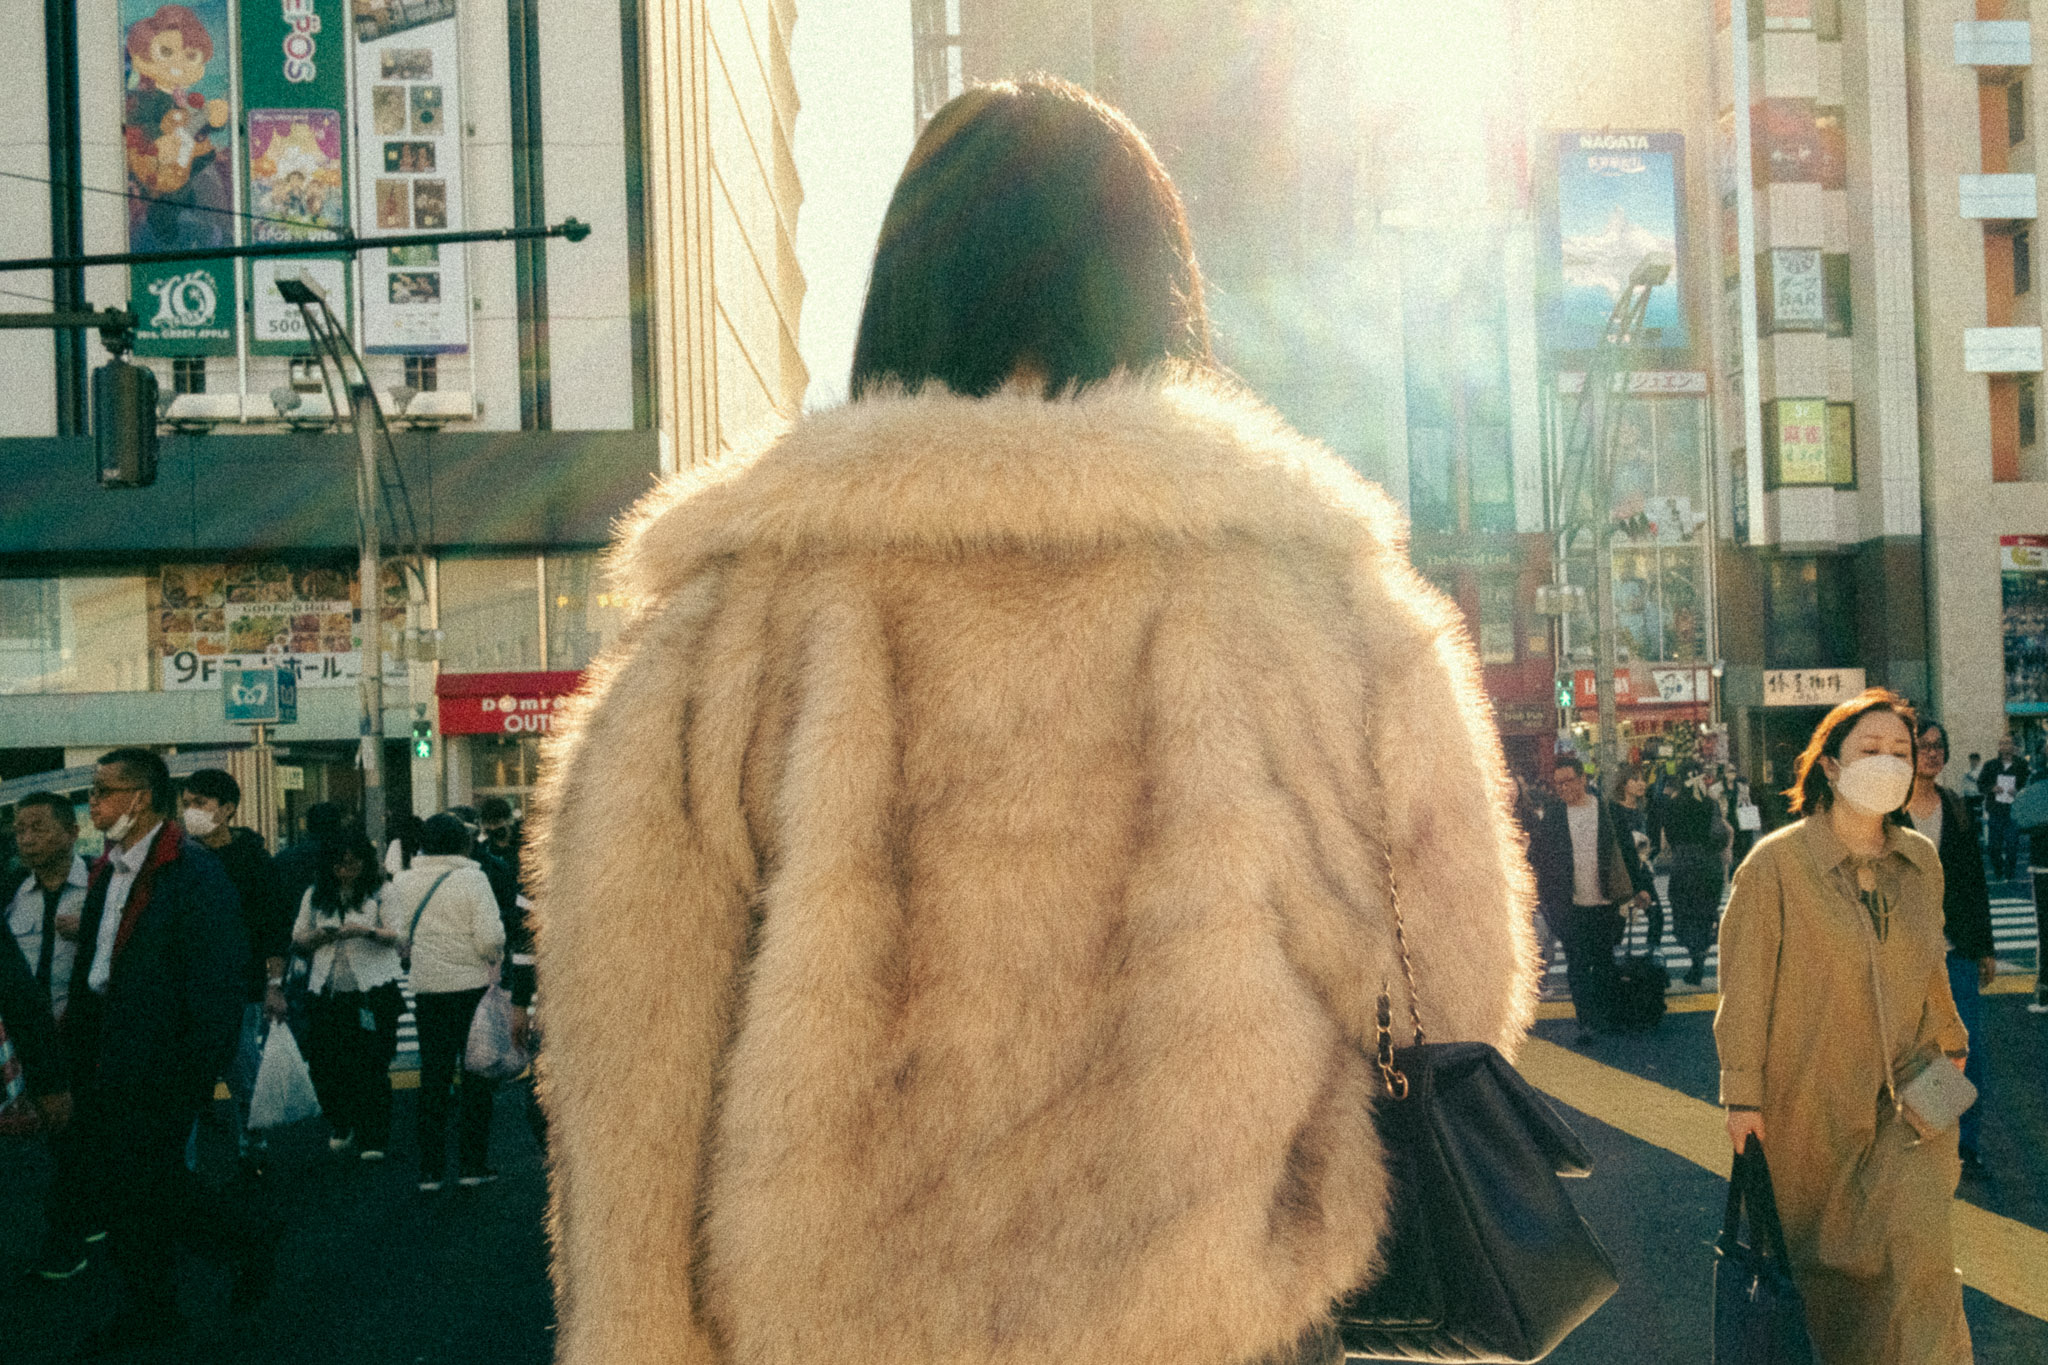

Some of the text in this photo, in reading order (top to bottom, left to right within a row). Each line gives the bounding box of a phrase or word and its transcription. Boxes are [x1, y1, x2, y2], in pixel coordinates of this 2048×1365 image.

[1580, 135, 1649, 150] NAGATA
[162, 329, 197, 339] GREEN
[198, 329, 230, 339] APPLE
